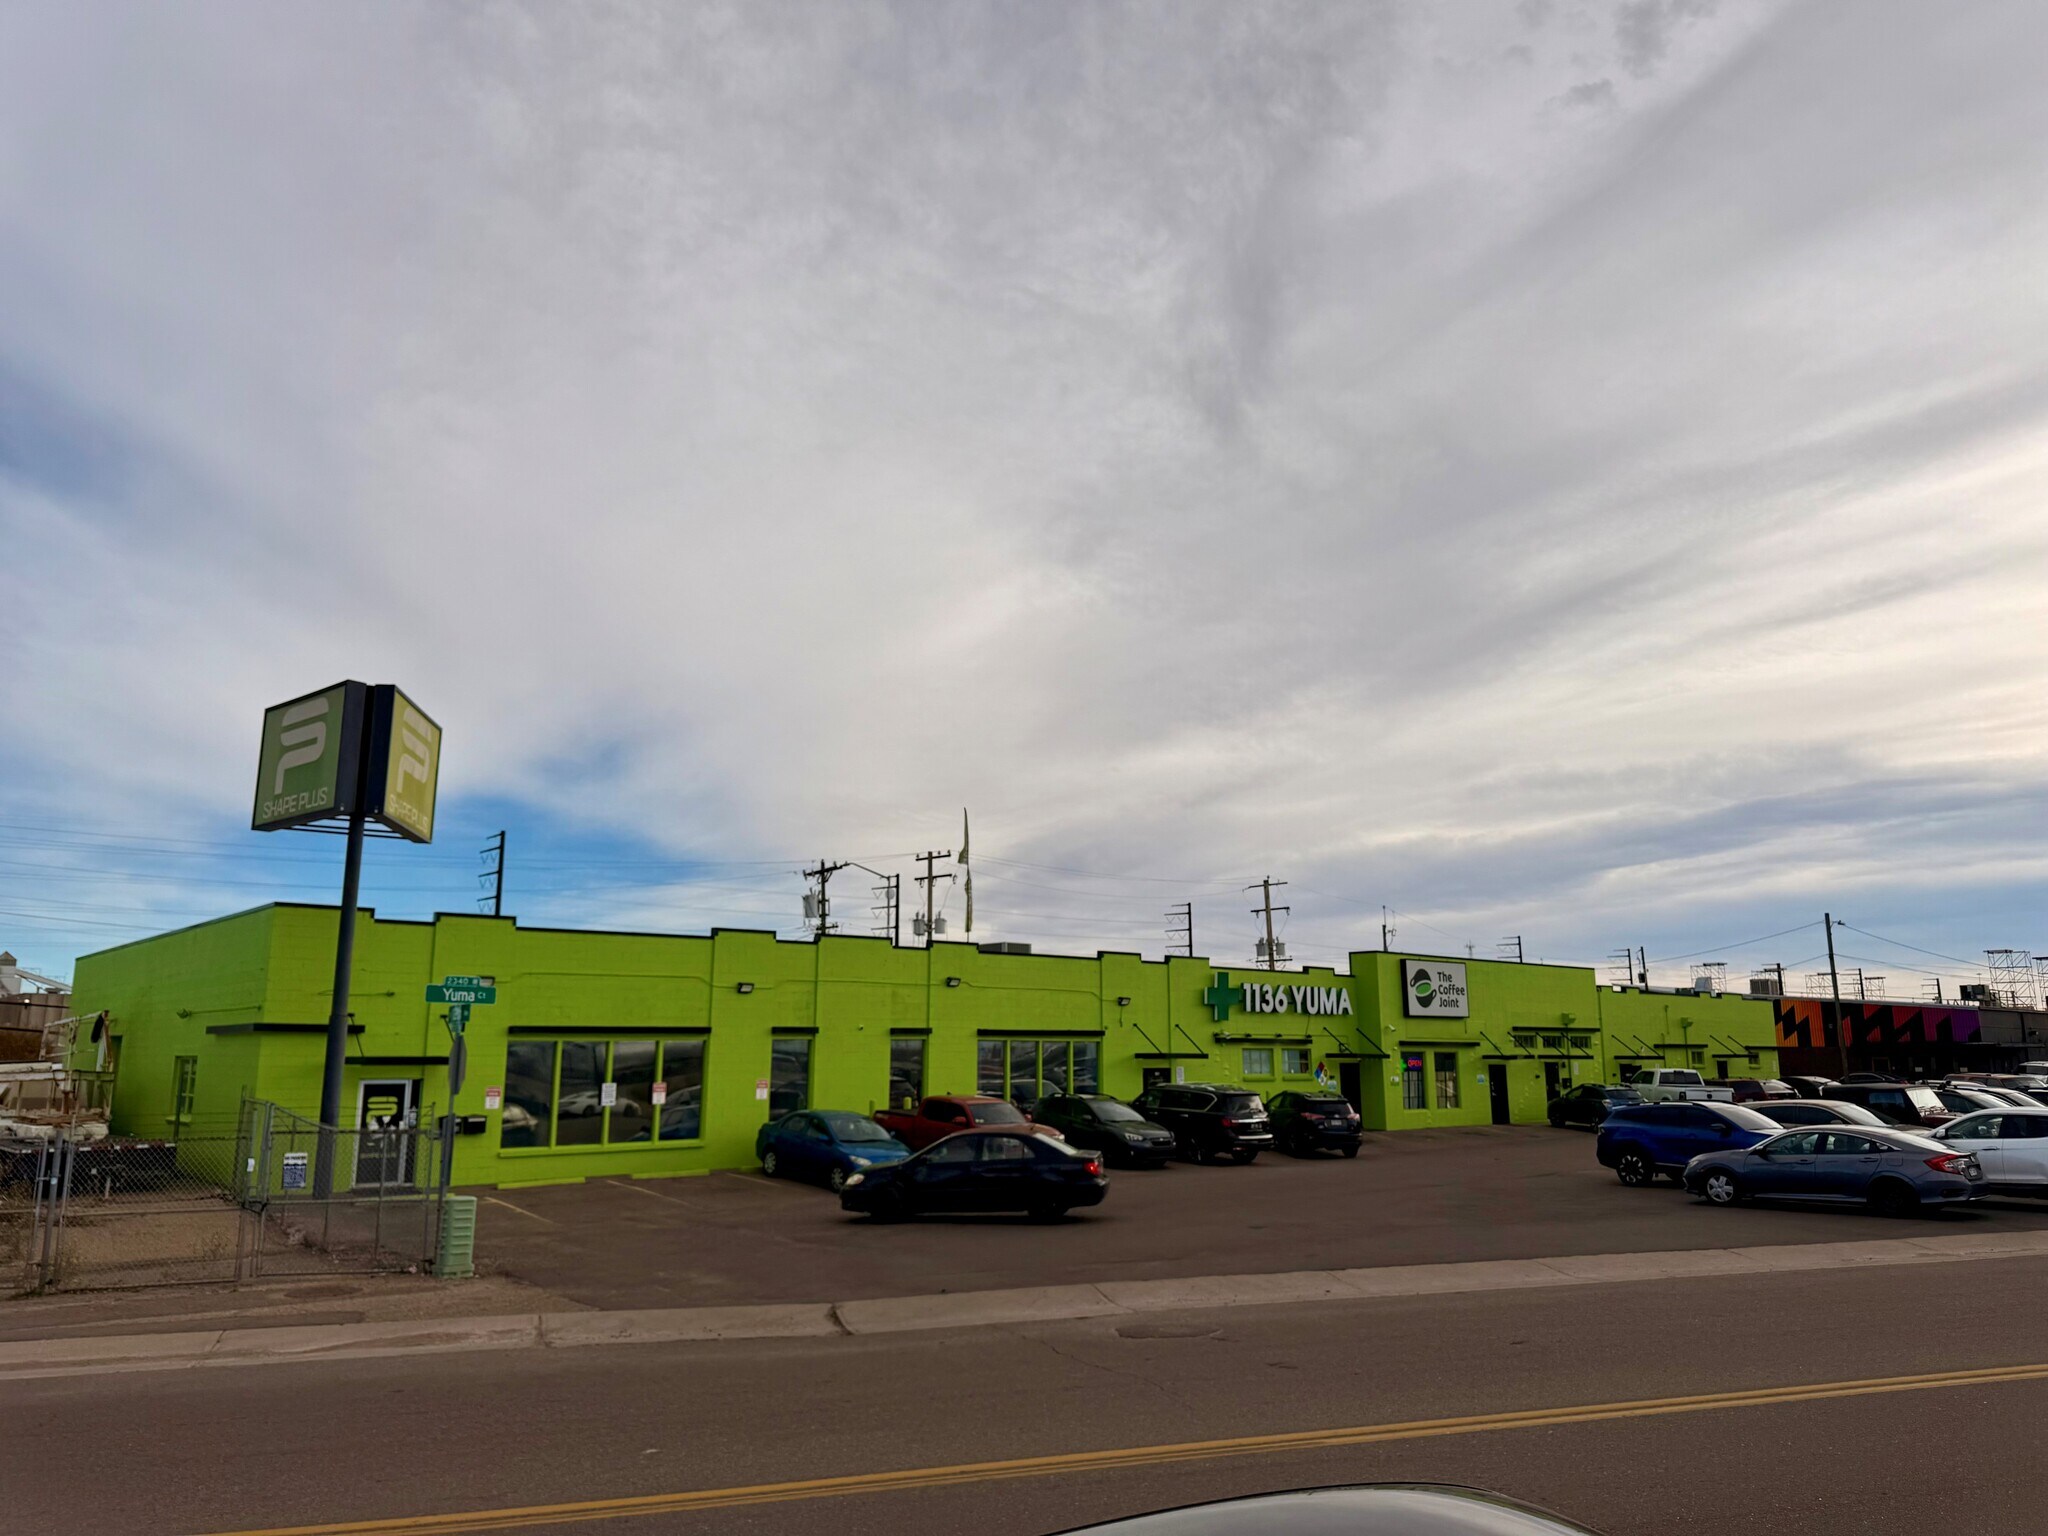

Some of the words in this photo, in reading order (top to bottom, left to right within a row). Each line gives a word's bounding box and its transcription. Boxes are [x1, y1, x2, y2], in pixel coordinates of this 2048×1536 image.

[262, 794, 298, 819] SHAPE
[298, 786, 328, 811] PLUS
[1437, 971, 1453, 983] The
[443, 988, 476, 1002] Yuma
[1437, 983, 1466, 996] Coffee
[1243, 982, 1288, 1014] 1136
[1290, 984, 1354, 1016] YUMA
[1438, 996, 1460, 1009] Joint
[1407, 1059, 1423, 1067] OPEN
